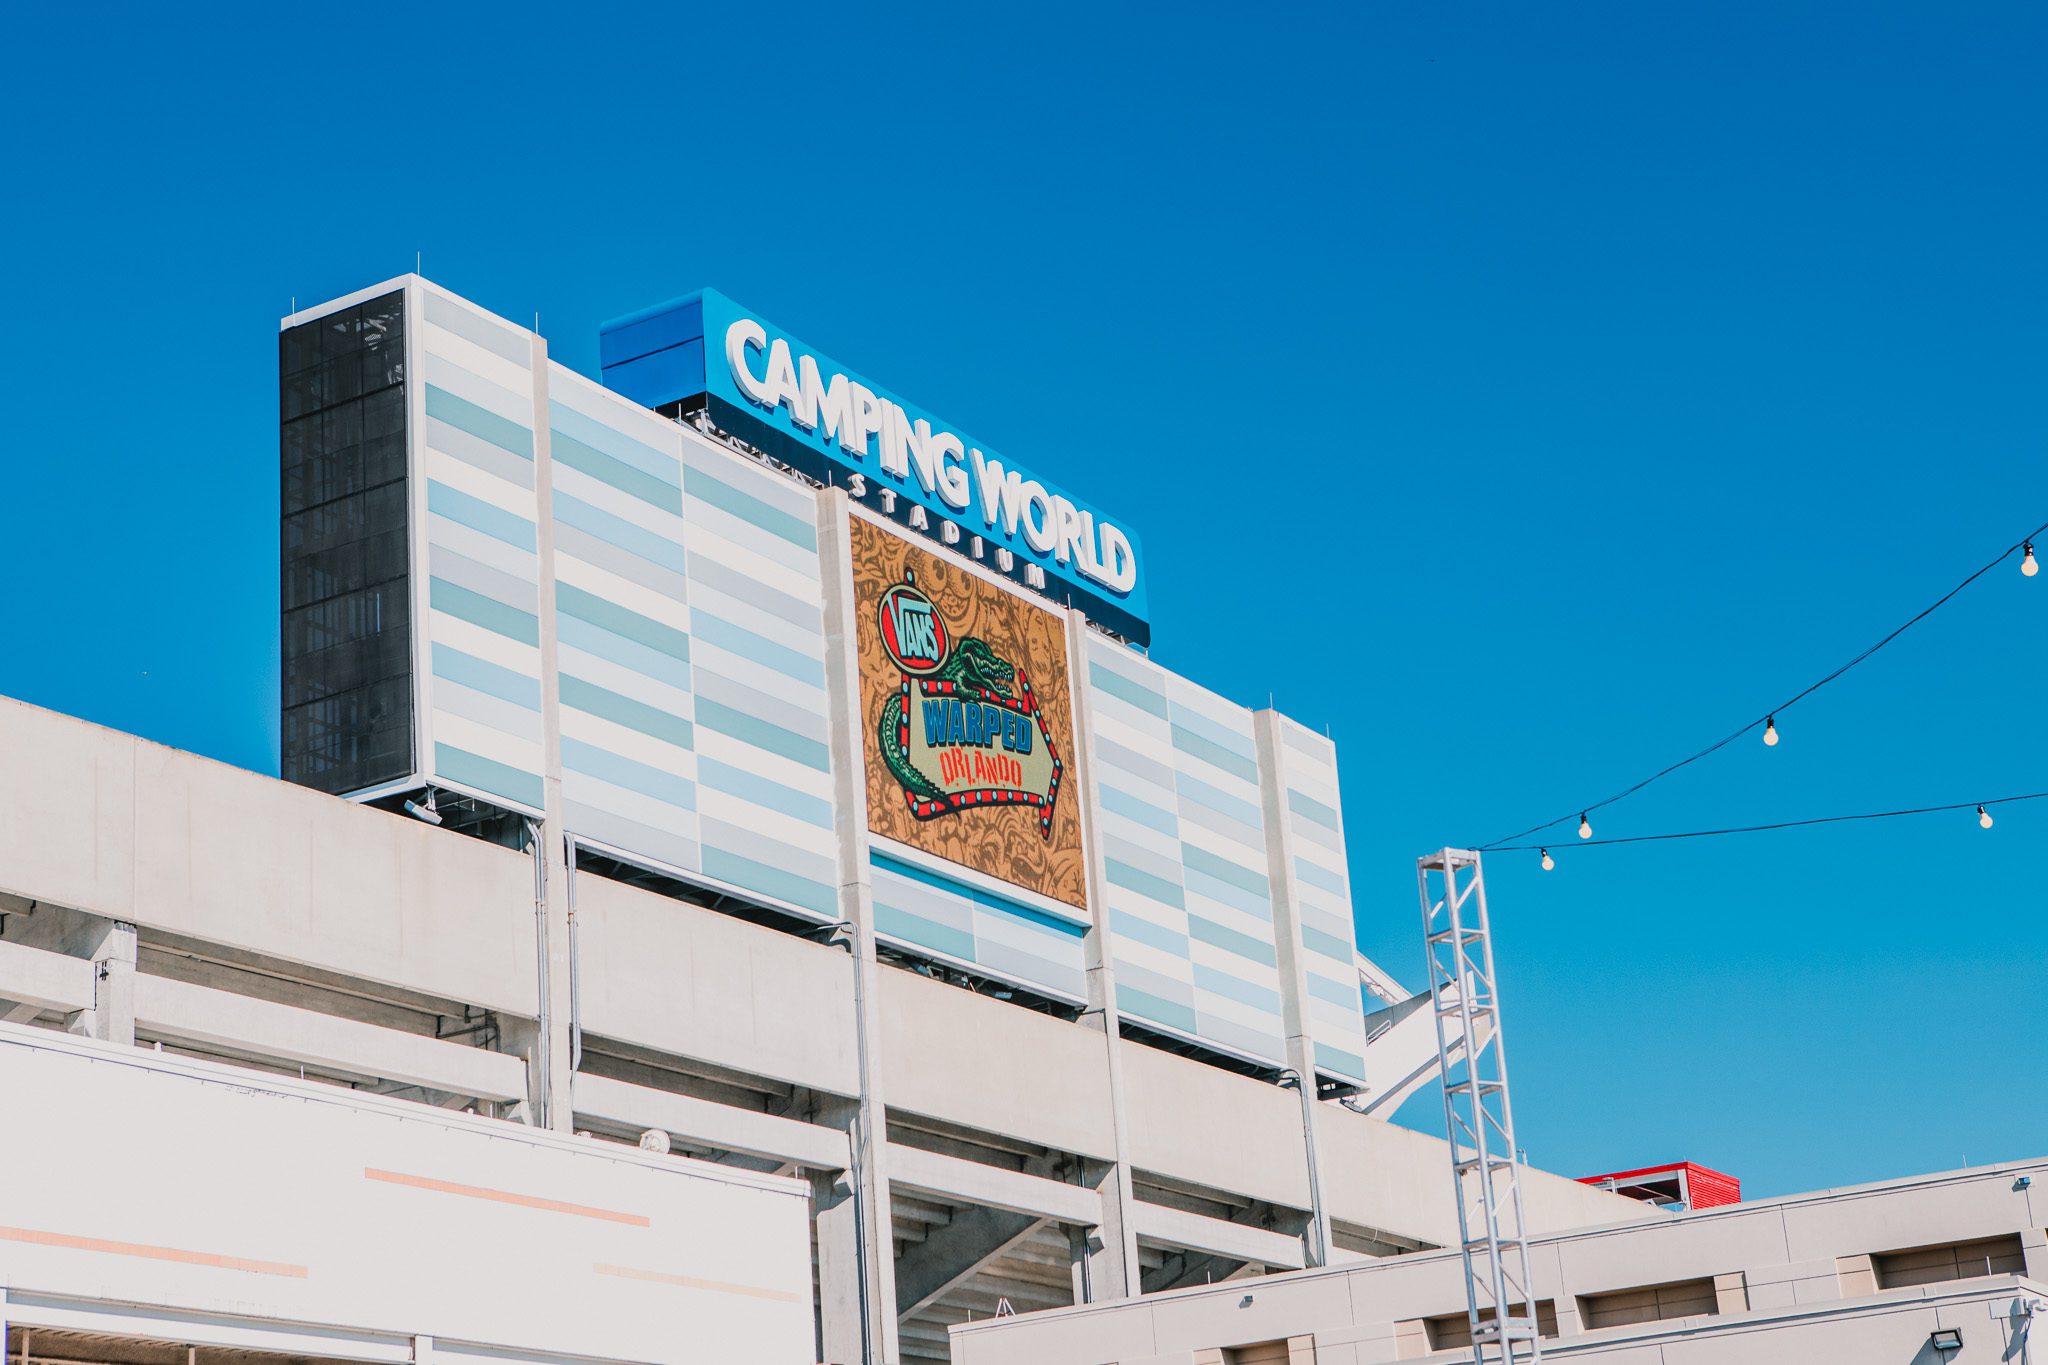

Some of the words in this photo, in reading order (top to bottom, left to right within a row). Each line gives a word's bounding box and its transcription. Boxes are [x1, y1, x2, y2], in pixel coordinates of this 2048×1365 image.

[726, 319, 970, 507] CAMPING
[969, 448, 1136, 593] WORLD
[849, 474, 1045, 589] STADIUM
[888, 592, 939, 661] VANS
[922, 699, 1033, 754] WARPED
[939, 747, 1022, 789] ORLANDO
